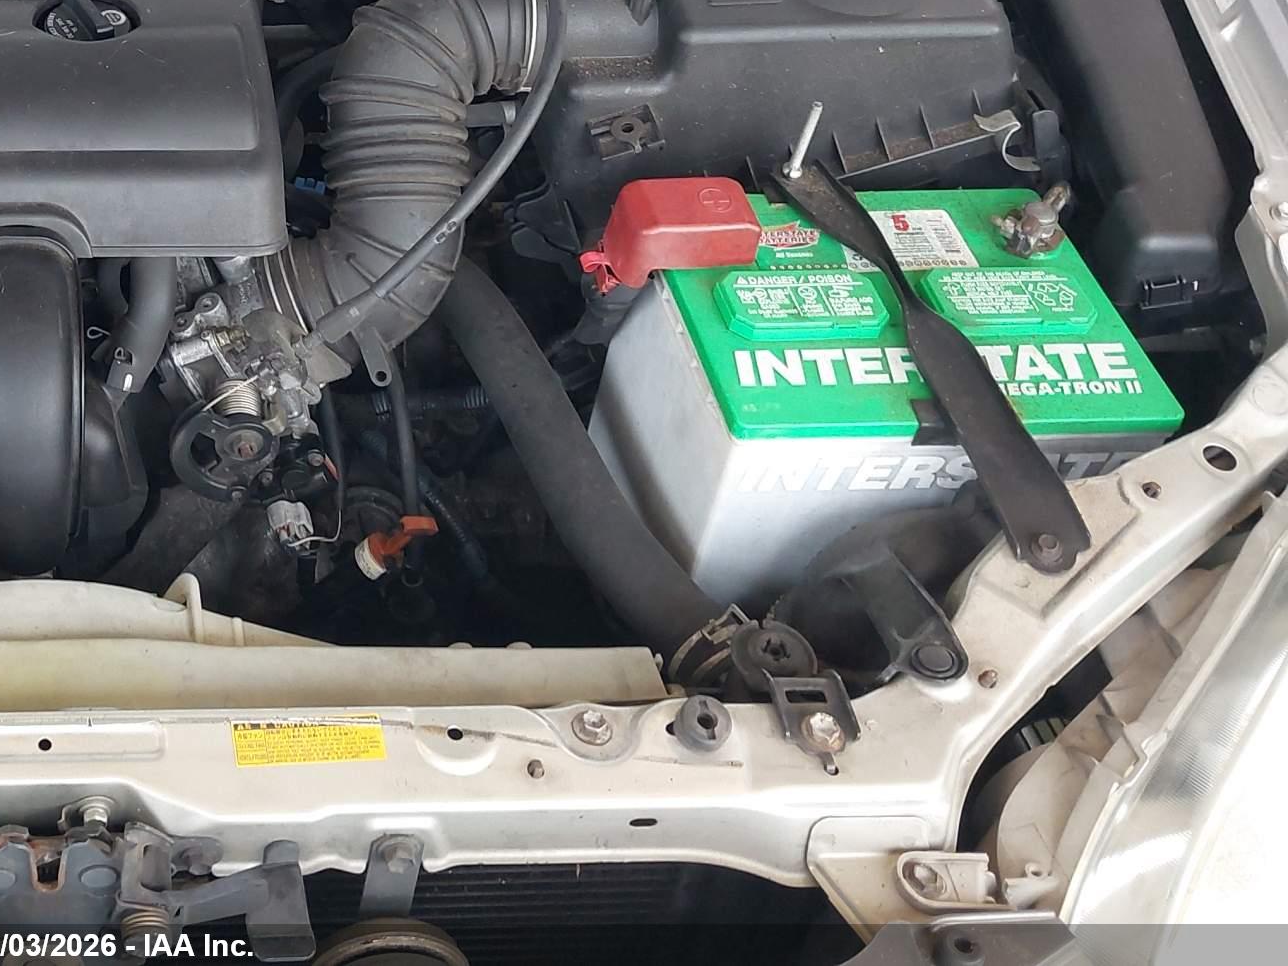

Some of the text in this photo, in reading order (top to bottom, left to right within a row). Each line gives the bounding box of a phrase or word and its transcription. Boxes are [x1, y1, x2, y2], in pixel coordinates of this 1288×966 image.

[891, 214, 909, 231] 5
[748, 276, 798, 284] DANGER
[808, 274, 853, 283] POISON
